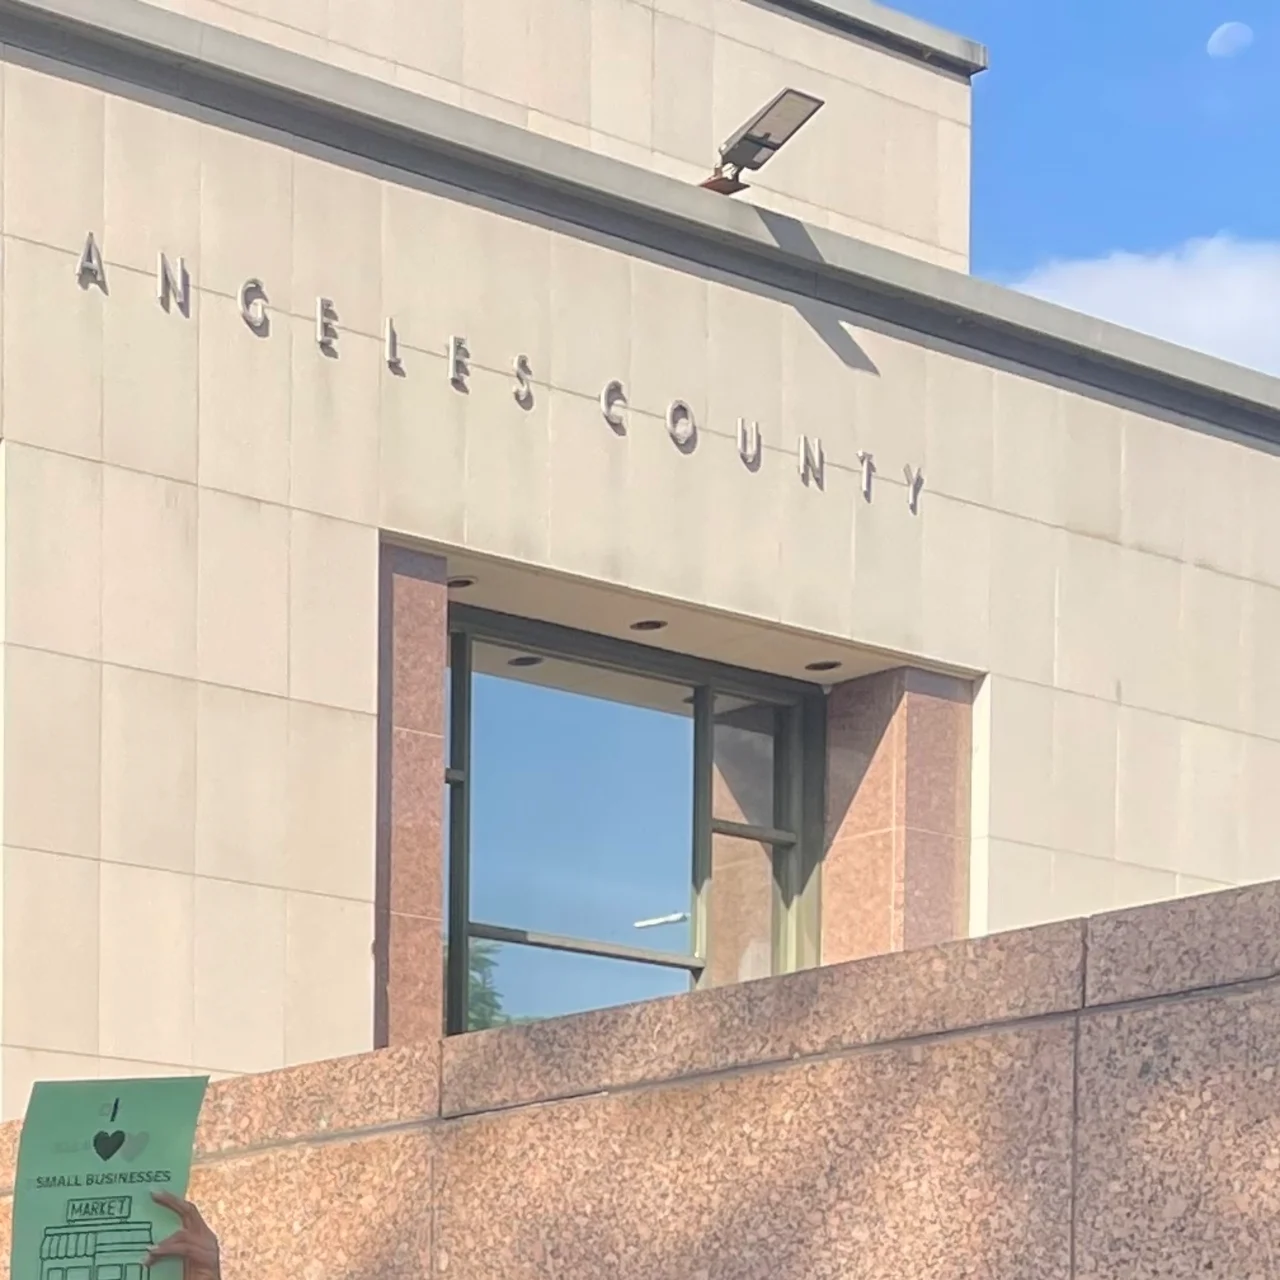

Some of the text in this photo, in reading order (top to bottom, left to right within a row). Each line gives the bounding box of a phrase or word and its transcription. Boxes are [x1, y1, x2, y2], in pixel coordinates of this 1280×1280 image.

[76, 231, 533, 404] ANGELES
[600, 380, 924, 512] COUNTY
[109, 1097, 120, 1123] I
[36, 1170, 172, 1189] SMALL BUSINESSES
[70, 1199, 126, 1217] MARKET
